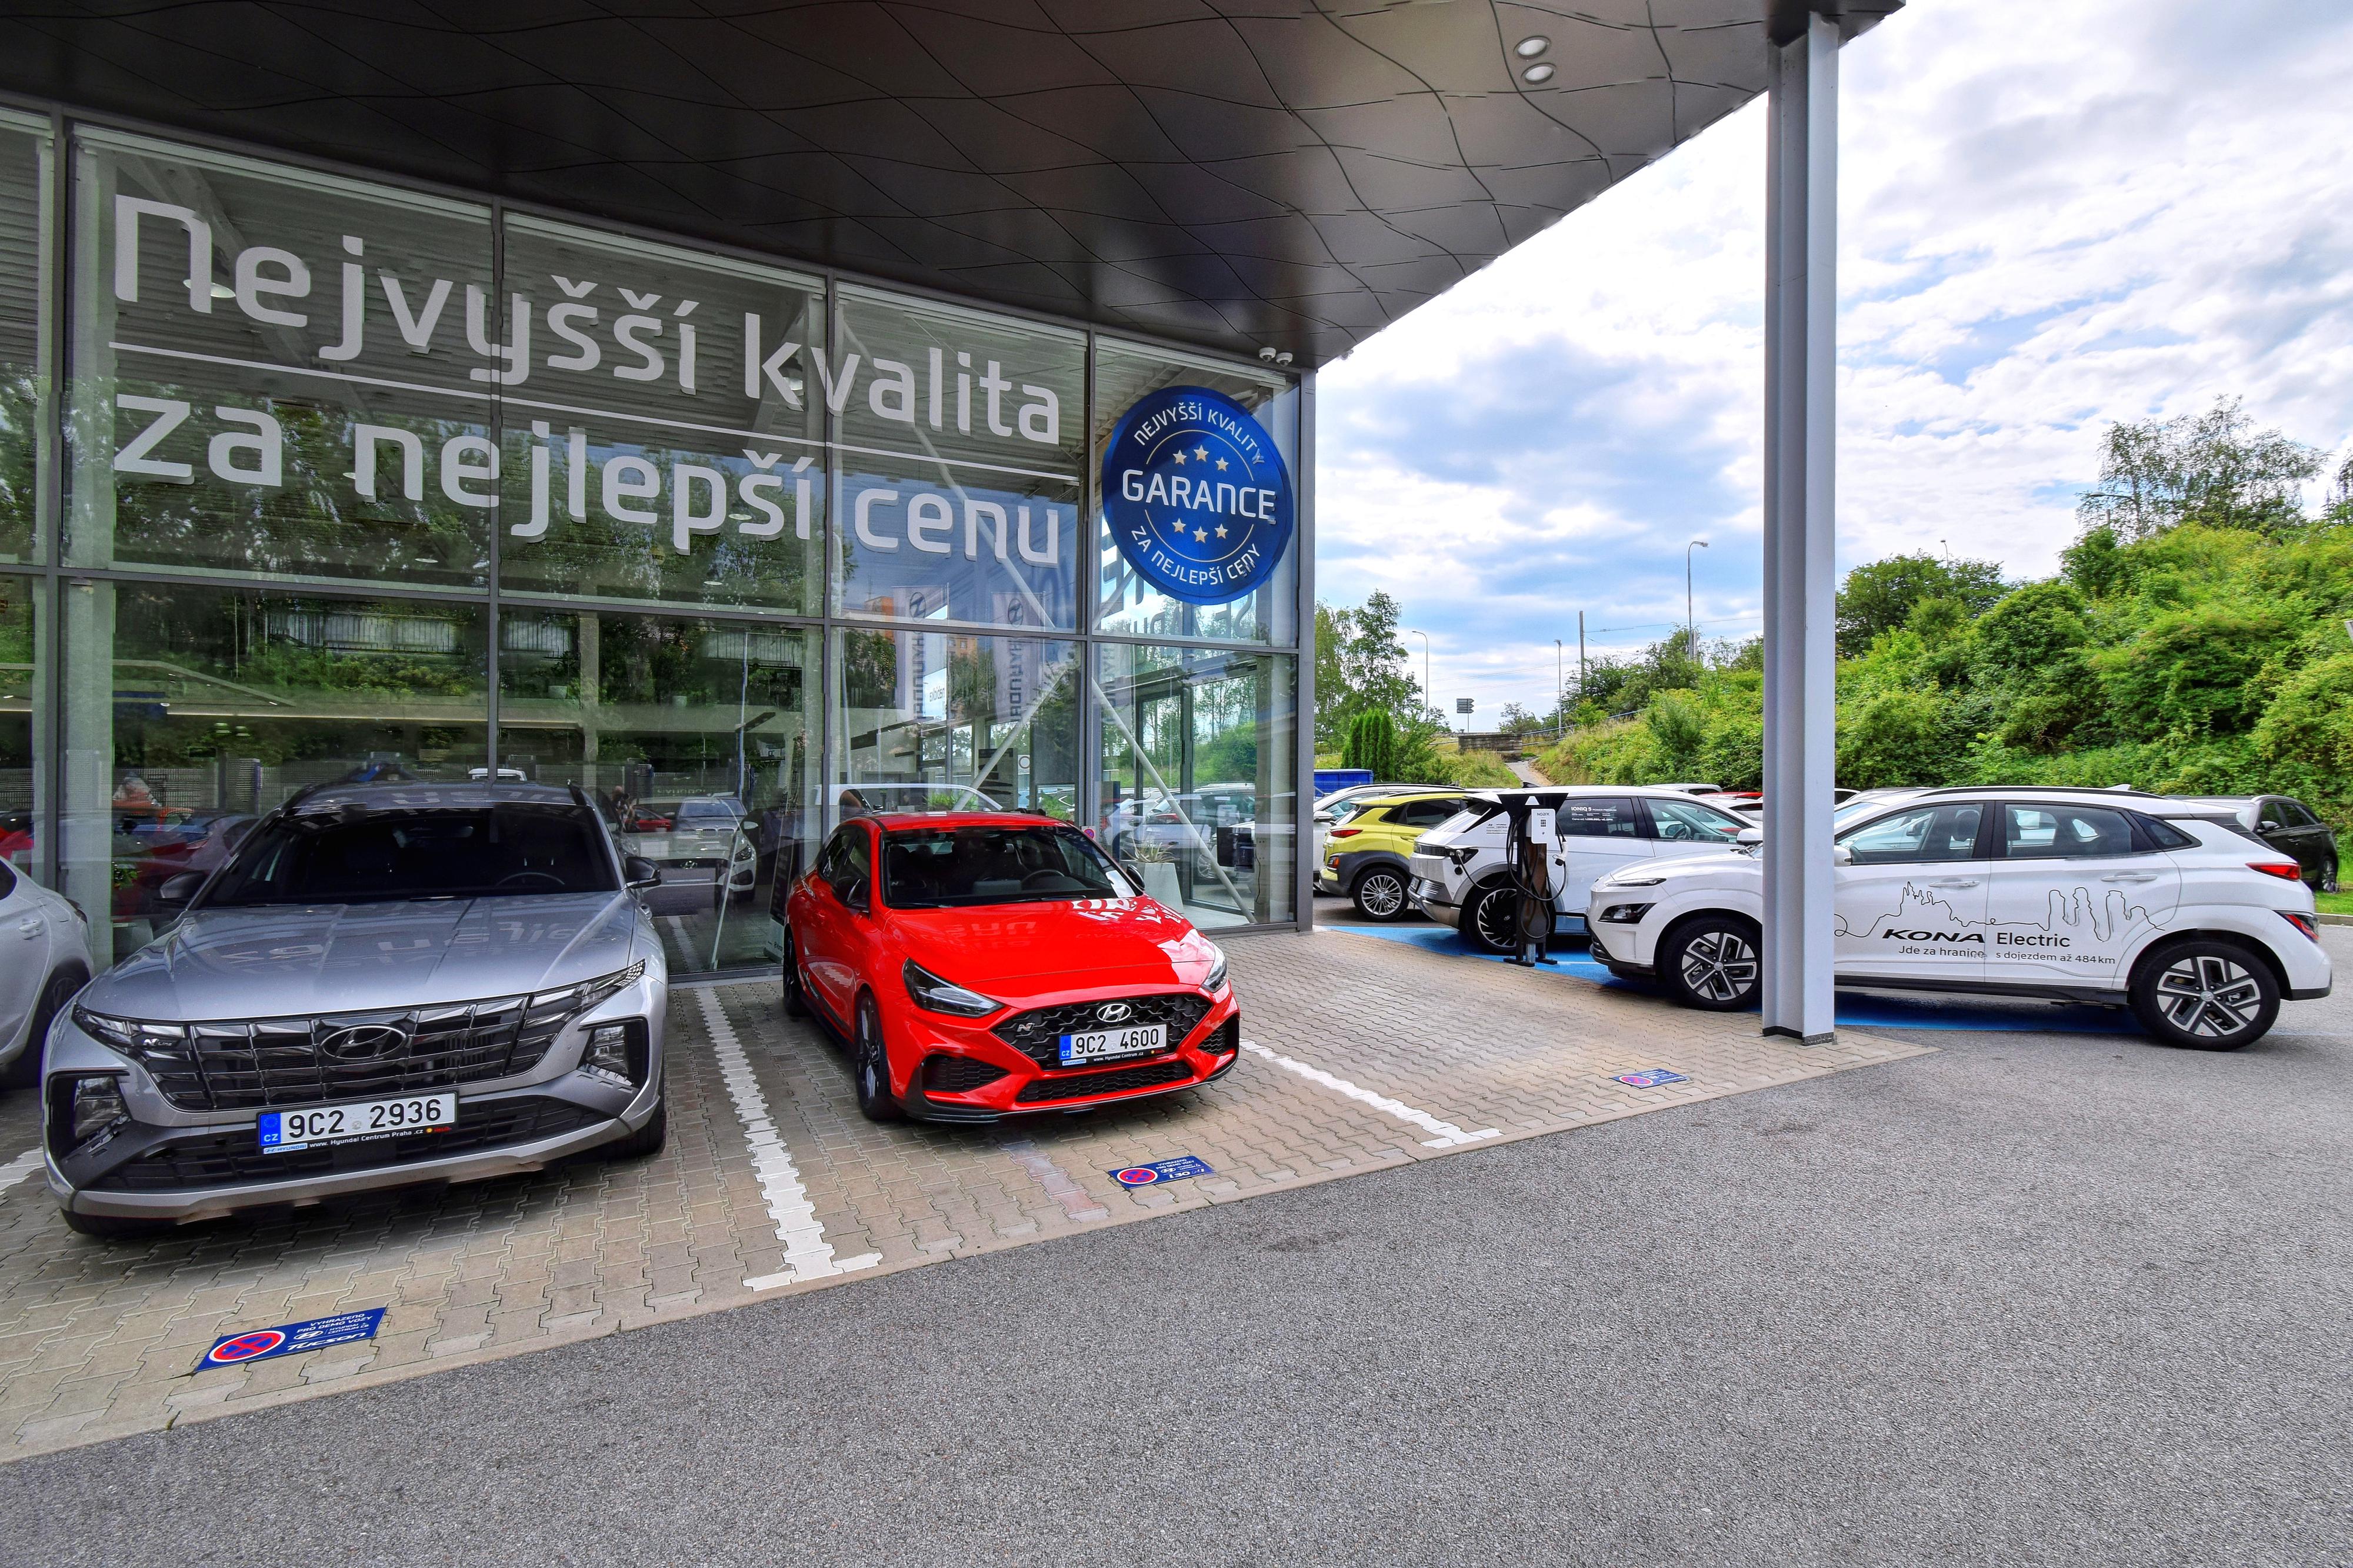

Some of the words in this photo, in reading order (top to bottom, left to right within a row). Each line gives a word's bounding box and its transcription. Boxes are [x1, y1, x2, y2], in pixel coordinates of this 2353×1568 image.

[744, 312, 1060, 444] kvalita
[1134, 403, 1202, 446] NEJVYŠŠÍ
[1208, 409, 1265, 465] KVALITY
[114, 394, 282, 487] za
[355, 420, 815, 555] nejlepší
[855, 488, 1058, 566] cenu
[1122, 469, 1276, 523] GARANCE
[1131, 526, 1152, 553] ZA
[1151, 549, 1224, 586] NEJLEPŠÍ
[1226, 543, 1261, 578] CENY
[1882, 928, 1986, 944] KONA
[1997, 932, 2071, 949] Electric
[1898, 945, 1920, 956] Jde
[1922, 947, 1937, 956] za
[2004, 950, 2057, 962] dojezdem
[2059, 953, 2072, 963] až
[1075, 1034, 1106, 1055] 9C2
[1119, 1028, 1159, 1049] 4600
[264, 1133, 279, 1143] CZ
[288, 1109, 345, 1139] 9C2
[369, 1098, 442, 1129] 2936
[277, 1143, 306, 1152] HYUNDAI
[330, 1137, 359, 1146] Hyundai
[361, 1133, 390, 1142] Centrum
[310, 1313, 365, 1326] VYHRAZENO
[318, 1320, 345, 1329] DEMO
[348, 1315, 374, 1323] VOZY
[328, 1326, 359, 1335] CENTRUM
